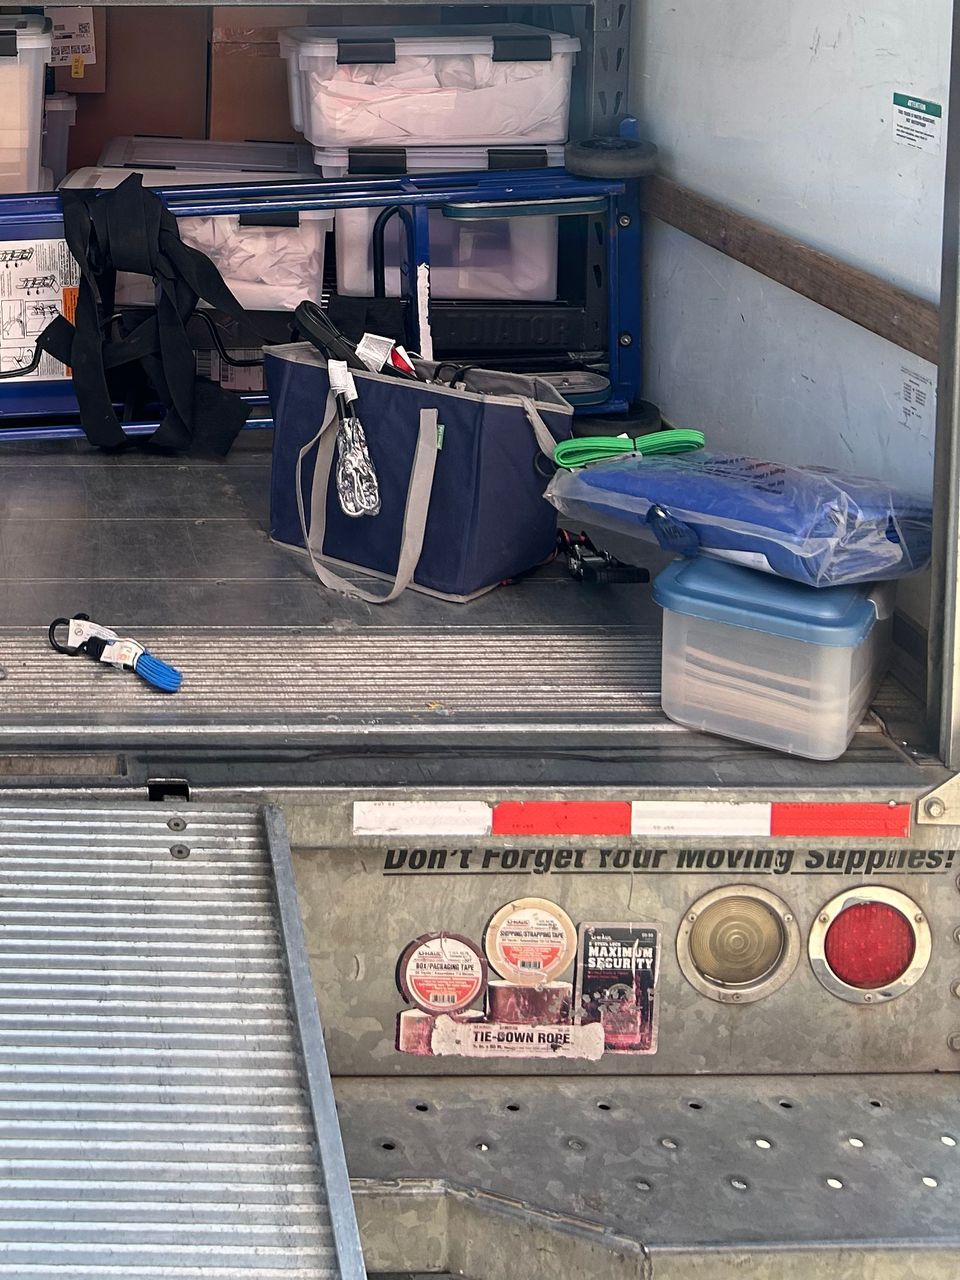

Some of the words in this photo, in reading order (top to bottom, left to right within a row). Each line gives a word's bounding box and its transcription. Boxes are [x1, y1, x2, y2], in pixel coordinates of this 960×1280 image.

[383, 848, 471, 872] Don't
[482, 848, 583, 876] Forget
[598, 848, 665, 871] Your
[676, 848, 793, 876] Moving
[805, 848, 955, 876] Supplies!
[500, 930, 551, 938] SHIPPING/STRAPPING
[588, 946, 653, 958] MAXIMUM
[473, 1031, 534, 1043] TIE-DOWN
[537, 1033, 570, 1044] ROPE
